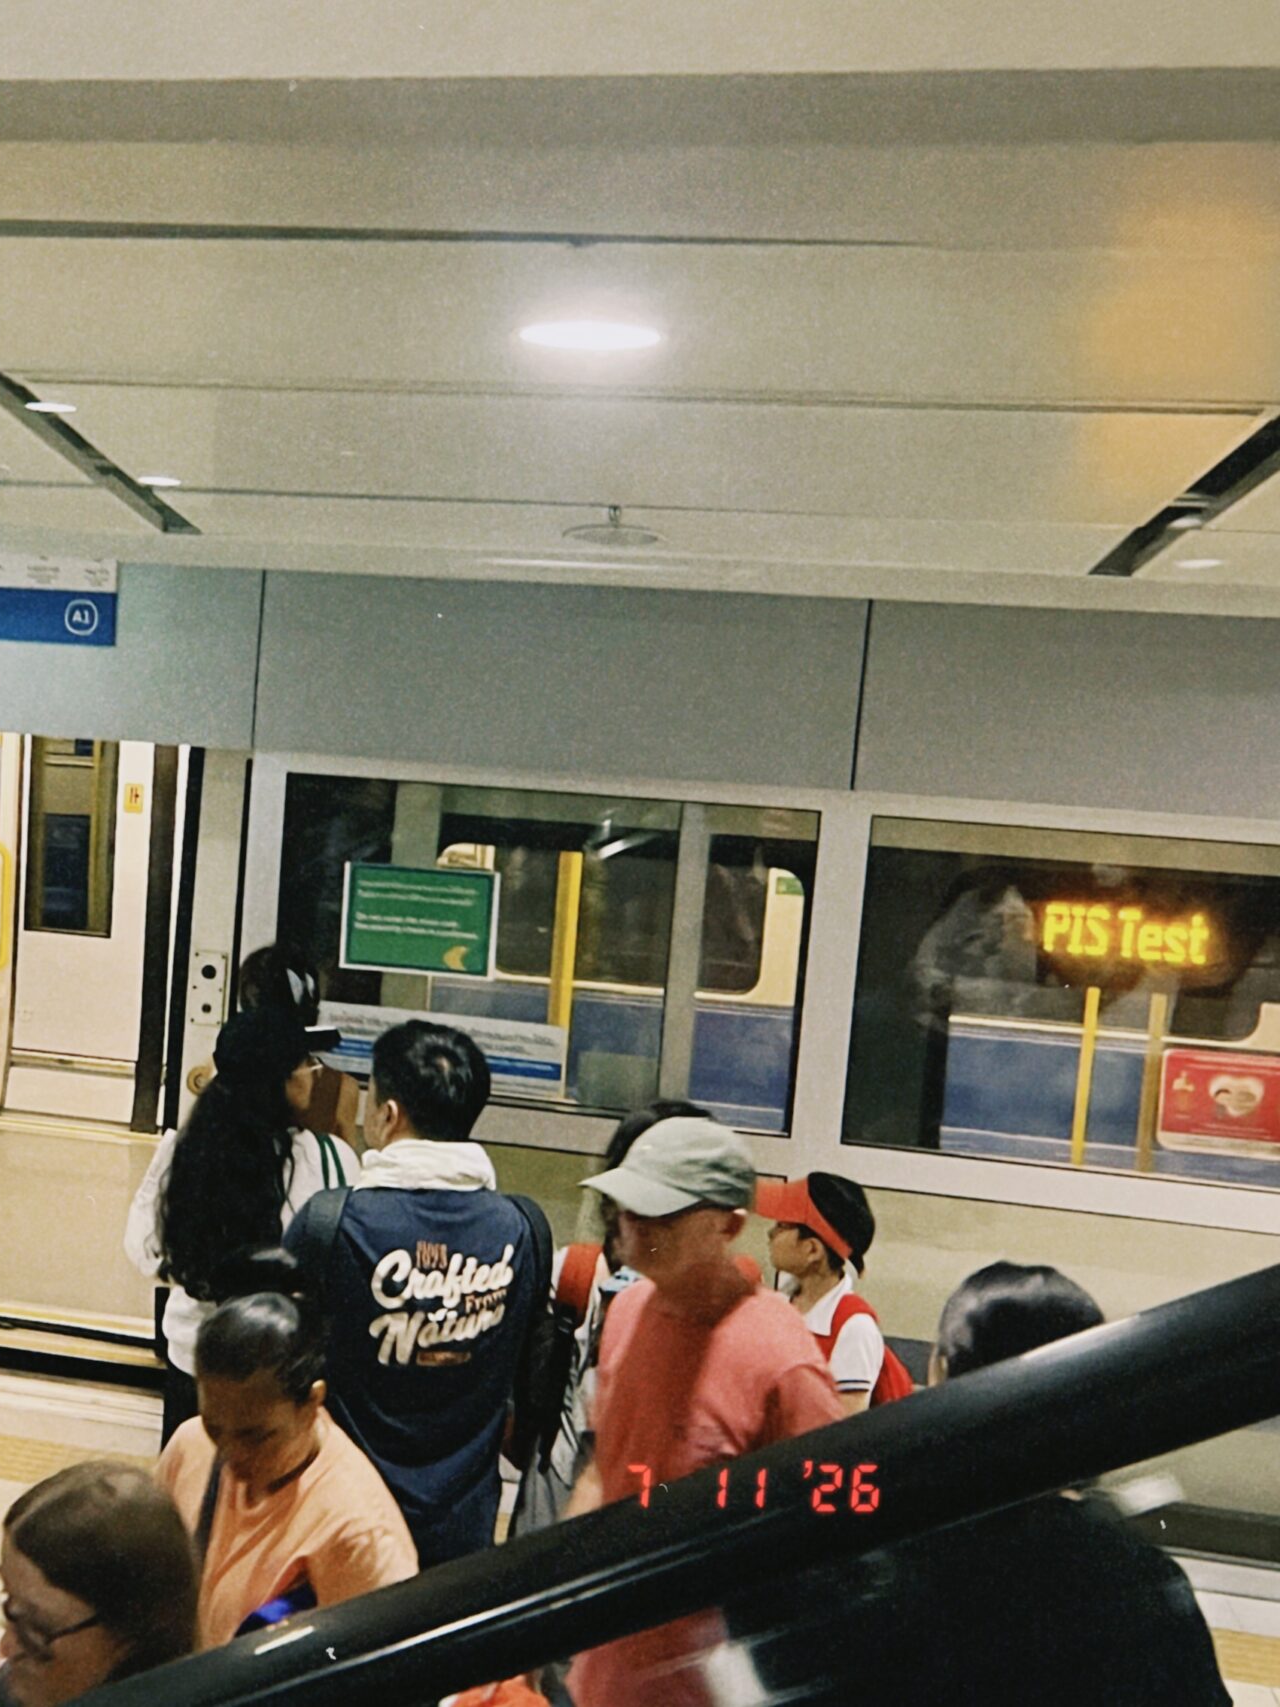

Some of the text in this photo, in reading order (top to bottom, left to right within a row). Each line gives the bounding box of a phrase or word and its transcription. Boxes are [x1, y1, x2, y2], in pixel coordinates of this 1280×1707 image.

[72, 609, 90, 625] A1
[1042, 901, 1210, 965] PIS Test
[371, 1244, 515, 1310] Crafted
[368, 1303, 506, 1366] Nature
